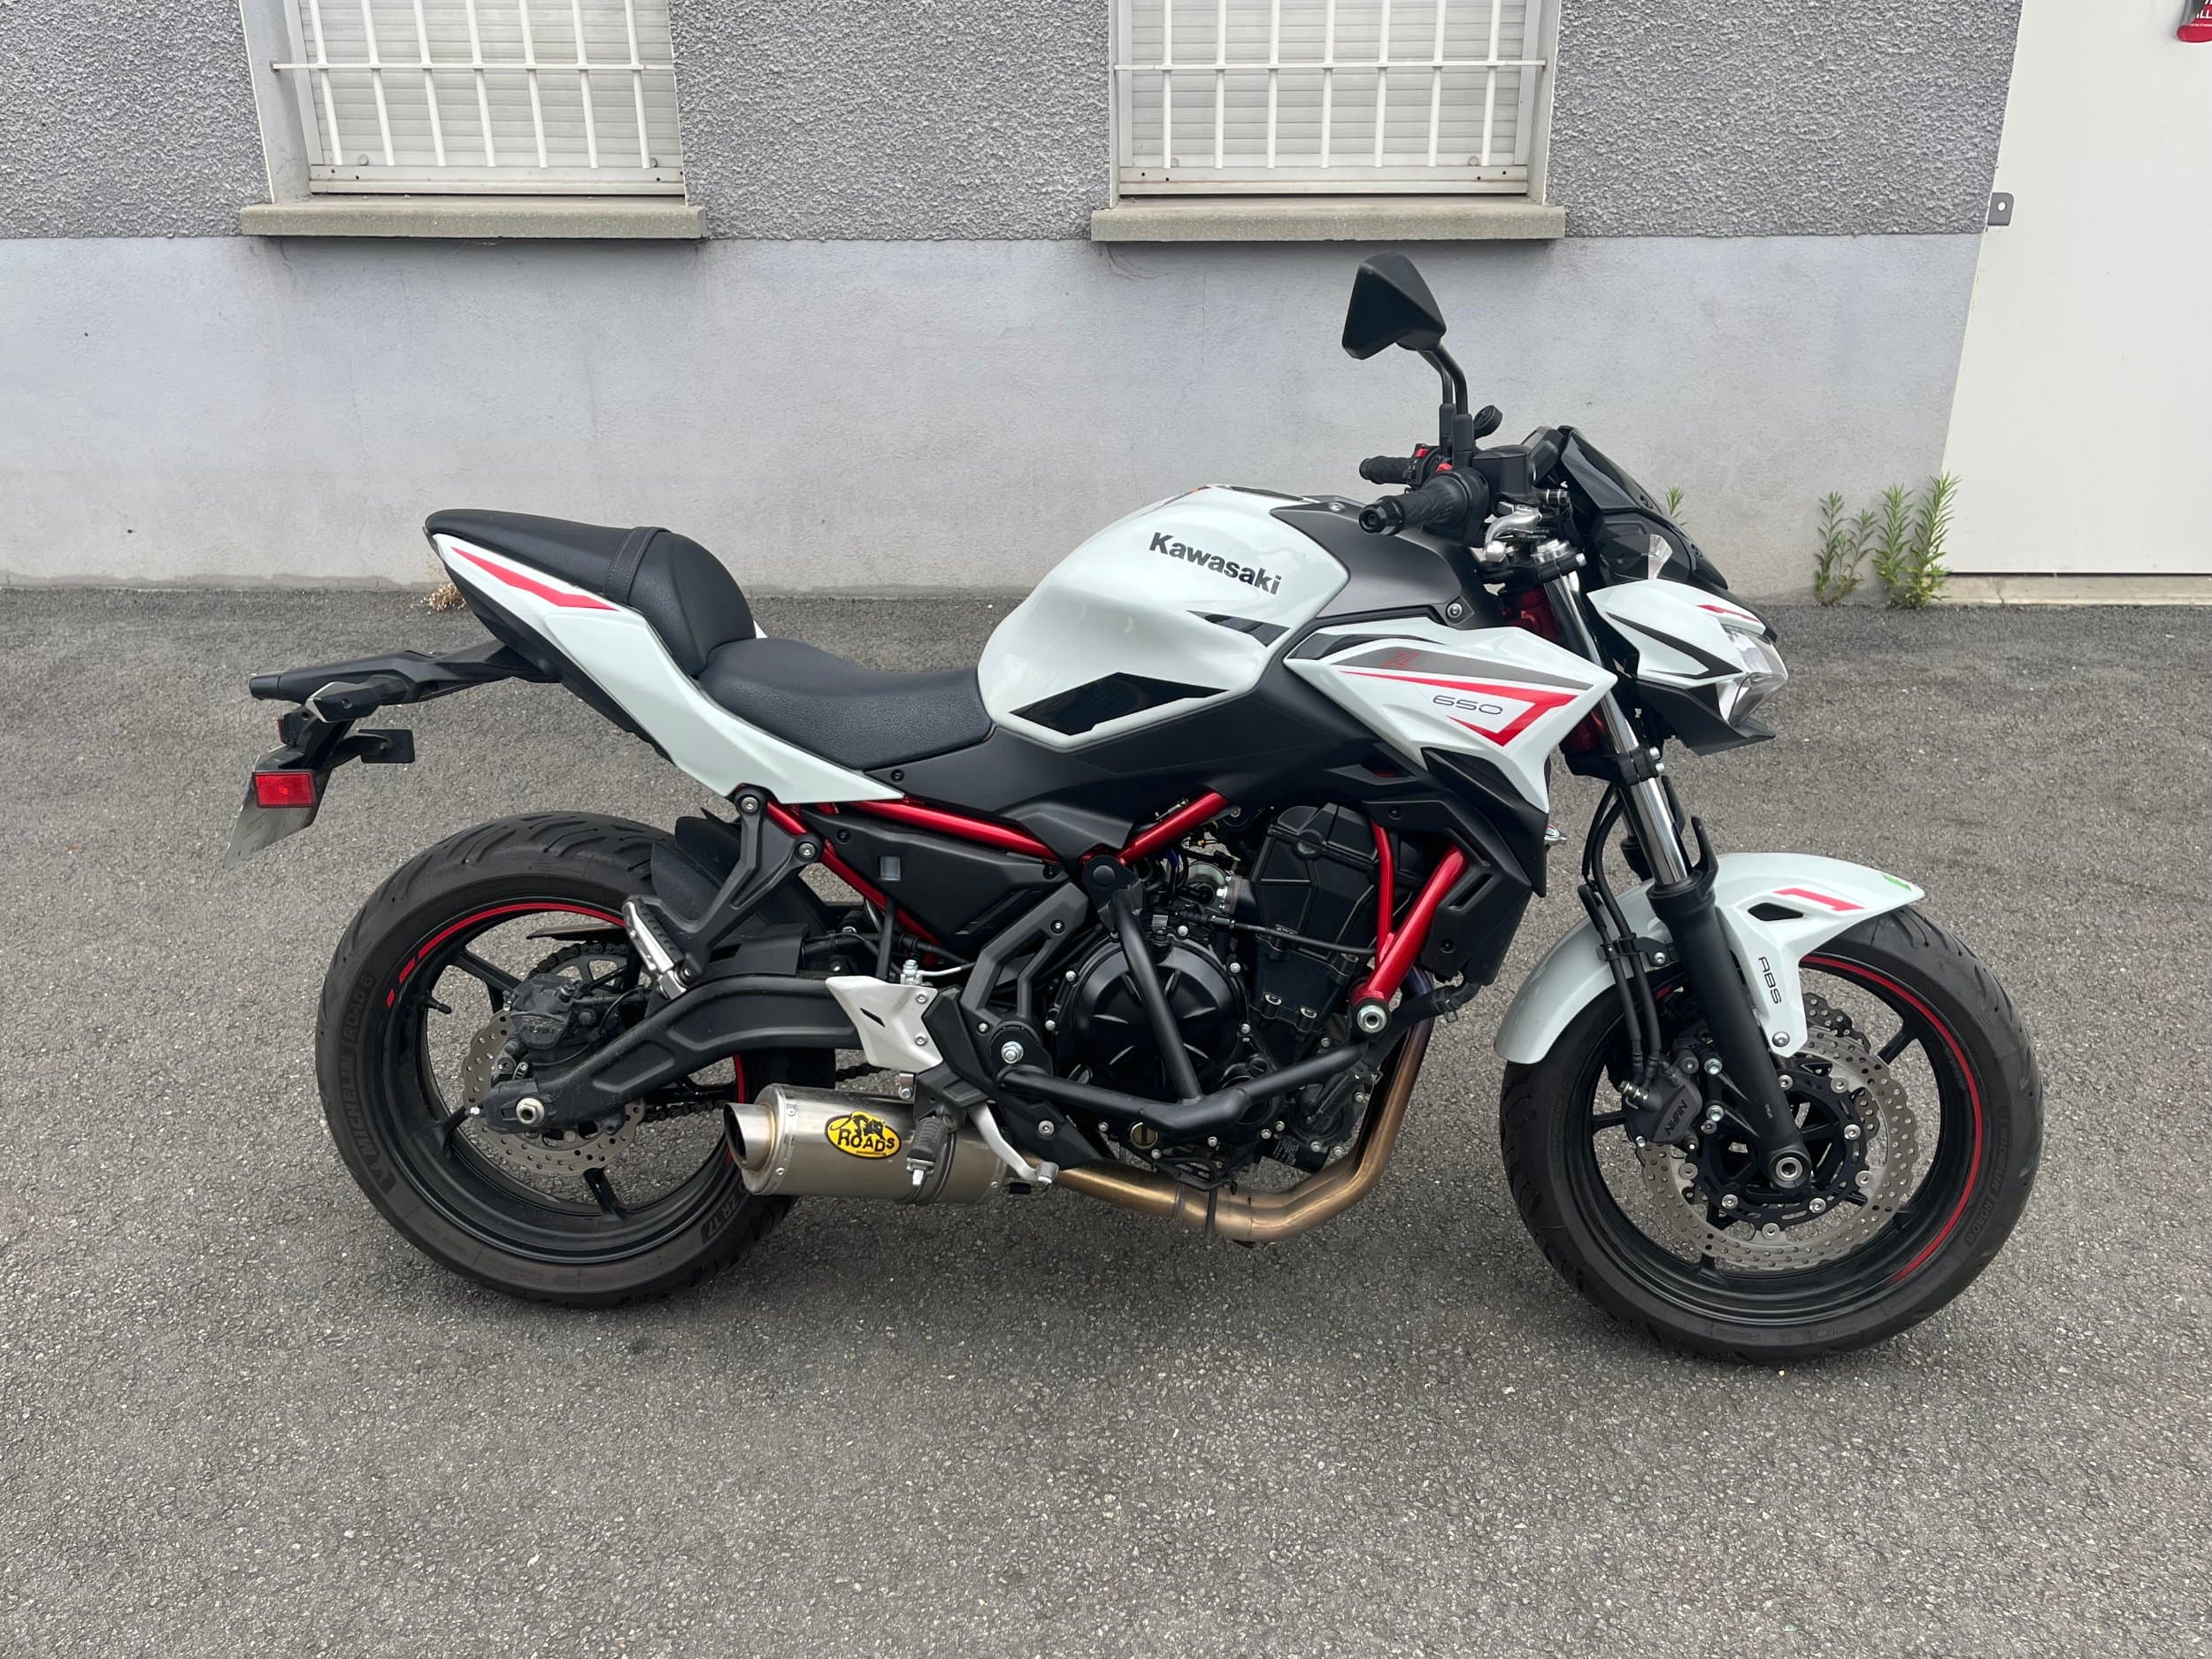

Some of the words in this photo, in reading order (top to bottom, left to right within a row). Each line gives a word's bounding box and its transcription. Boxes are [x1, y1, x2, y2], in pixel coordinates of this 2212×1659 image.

[1148, 532, 1282, 595] Kawasaki
[1432, 695, 1503, 716] 650
[1758, 956, 1782, 1004] ABS
[341, 1055, 377, 1157] MICHELIN
[837, 1128, 895, 1152] ROADS
